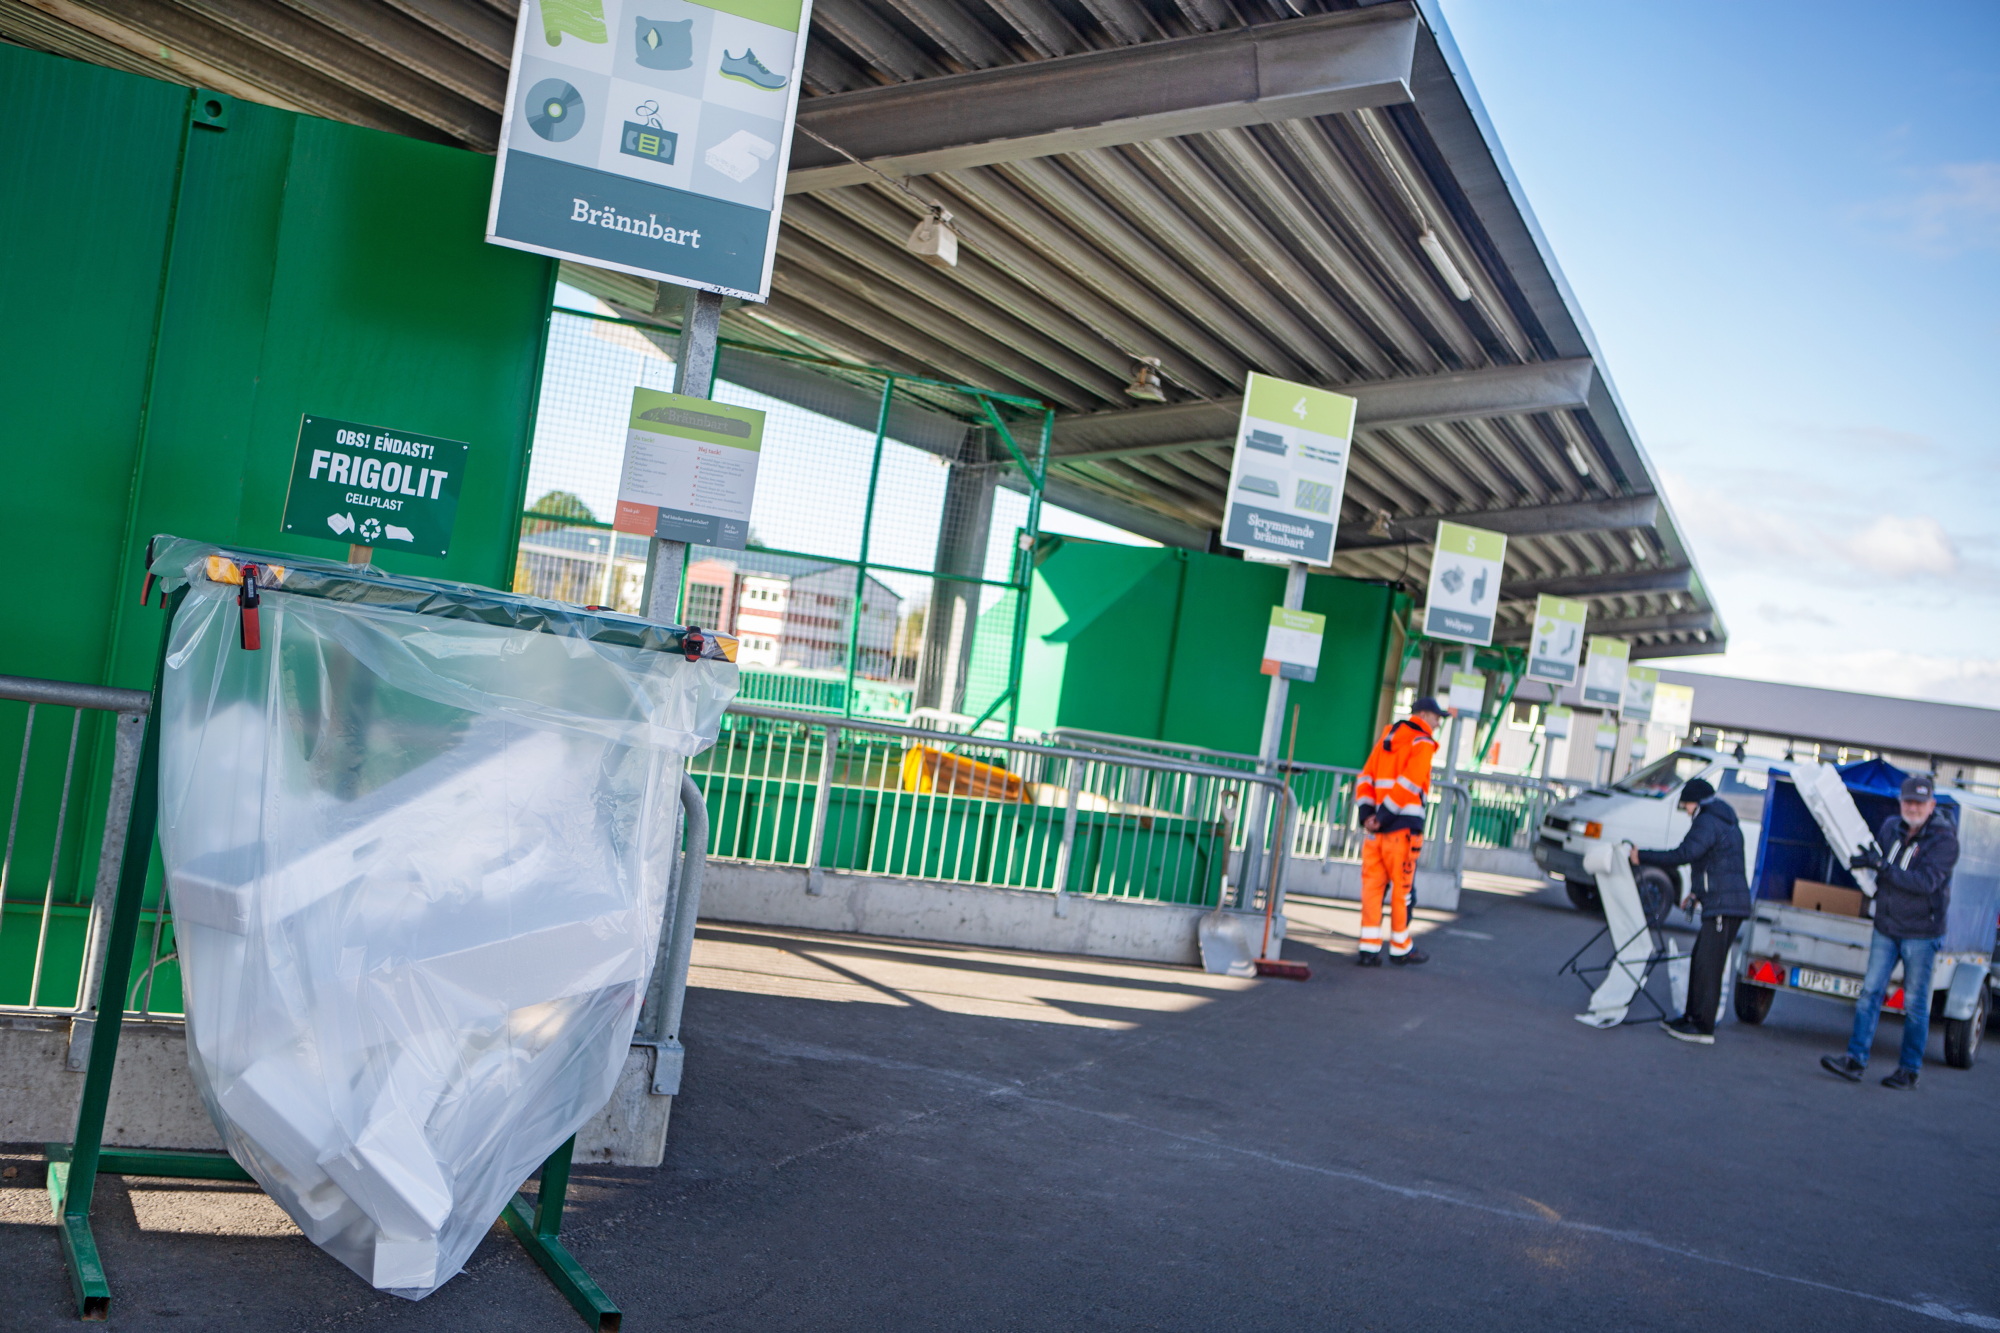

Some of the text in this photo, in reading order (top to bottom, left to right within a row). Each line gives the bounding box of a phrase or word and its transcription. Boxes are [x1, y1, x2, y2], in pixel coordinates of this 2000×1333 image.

[570, 198, 701, 249] Brännbart
[667, 409, 729, 432] Brännbart
[1292, 396, 1308, 421] 4
[336, 429, 435, 460] OBS! ENDAST!
[309, 449, 448, 500] FRIGOLIT
[345, 492, 404, 511] CELLPLAST
[1247, 513, 1315, 539] Skrymmande
[1253, 526, 1305, 550] brännbart
[1466, 535, 1476, 553] 5
[1802, 969, 1862, 997] UPC 36
